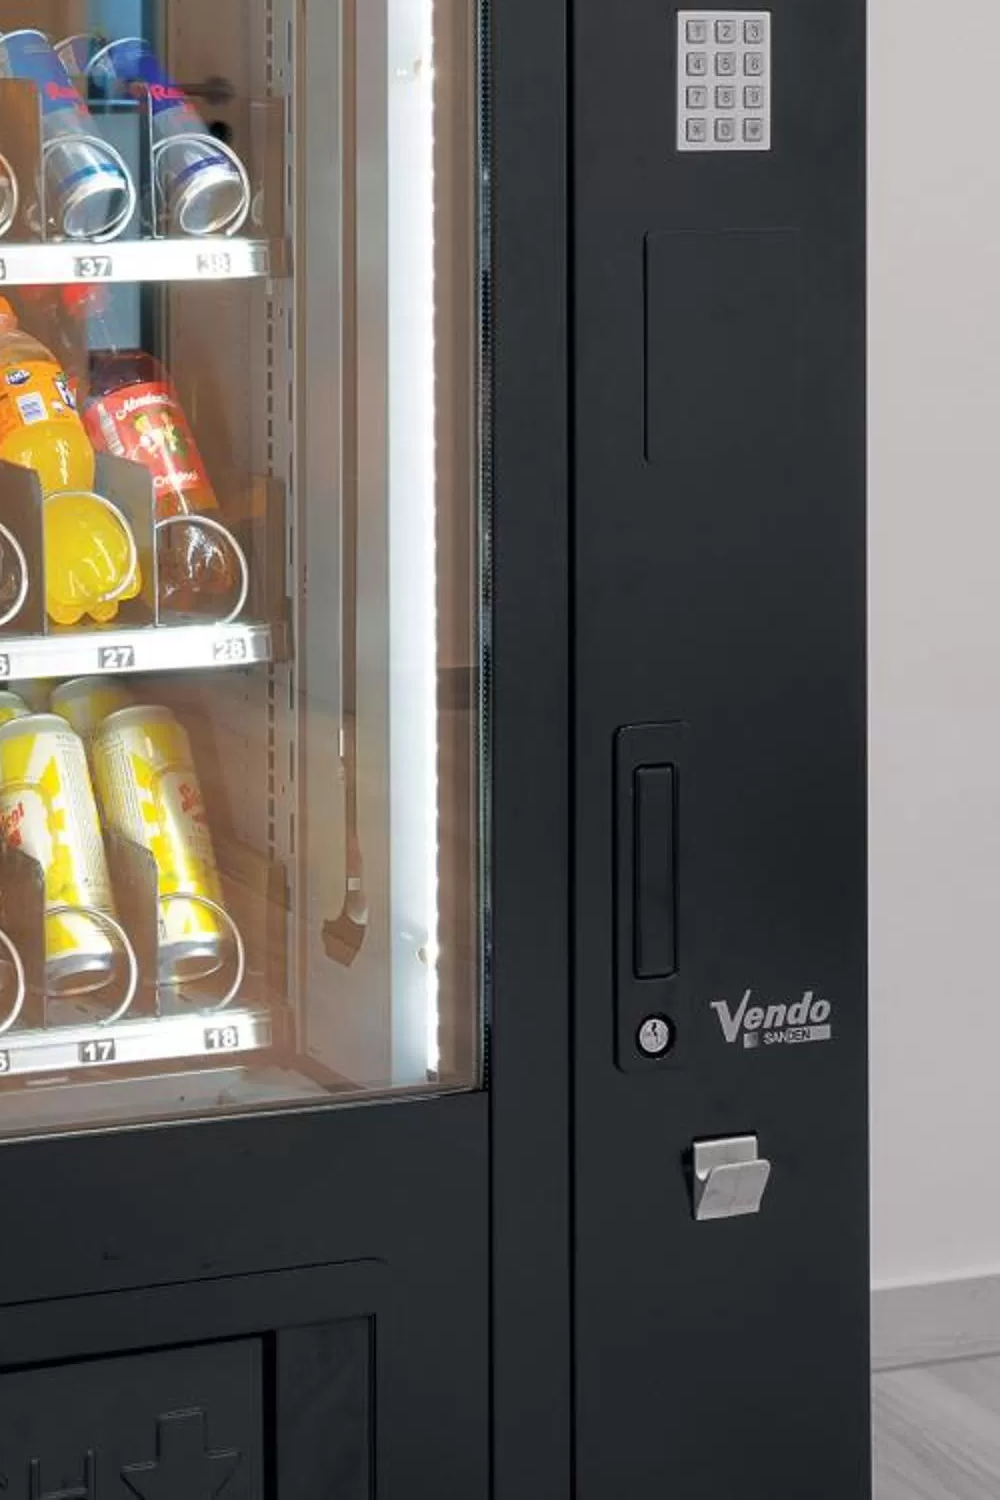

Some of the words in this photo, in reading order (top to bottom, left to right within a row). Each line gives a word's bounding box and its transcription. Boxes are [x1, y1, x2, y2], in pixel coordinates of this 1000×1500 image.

[81, 258, 110, 277] 37
[103, 648, 132, 668] 27
[217, 641, 246, 660] 28
[709, 988, 832, 1043] Vendo
[207, 1028, 237, 1048] 18
[763, 1027, 812, 1045] SANDEN
[85, 1042, 114, 1063] 17
